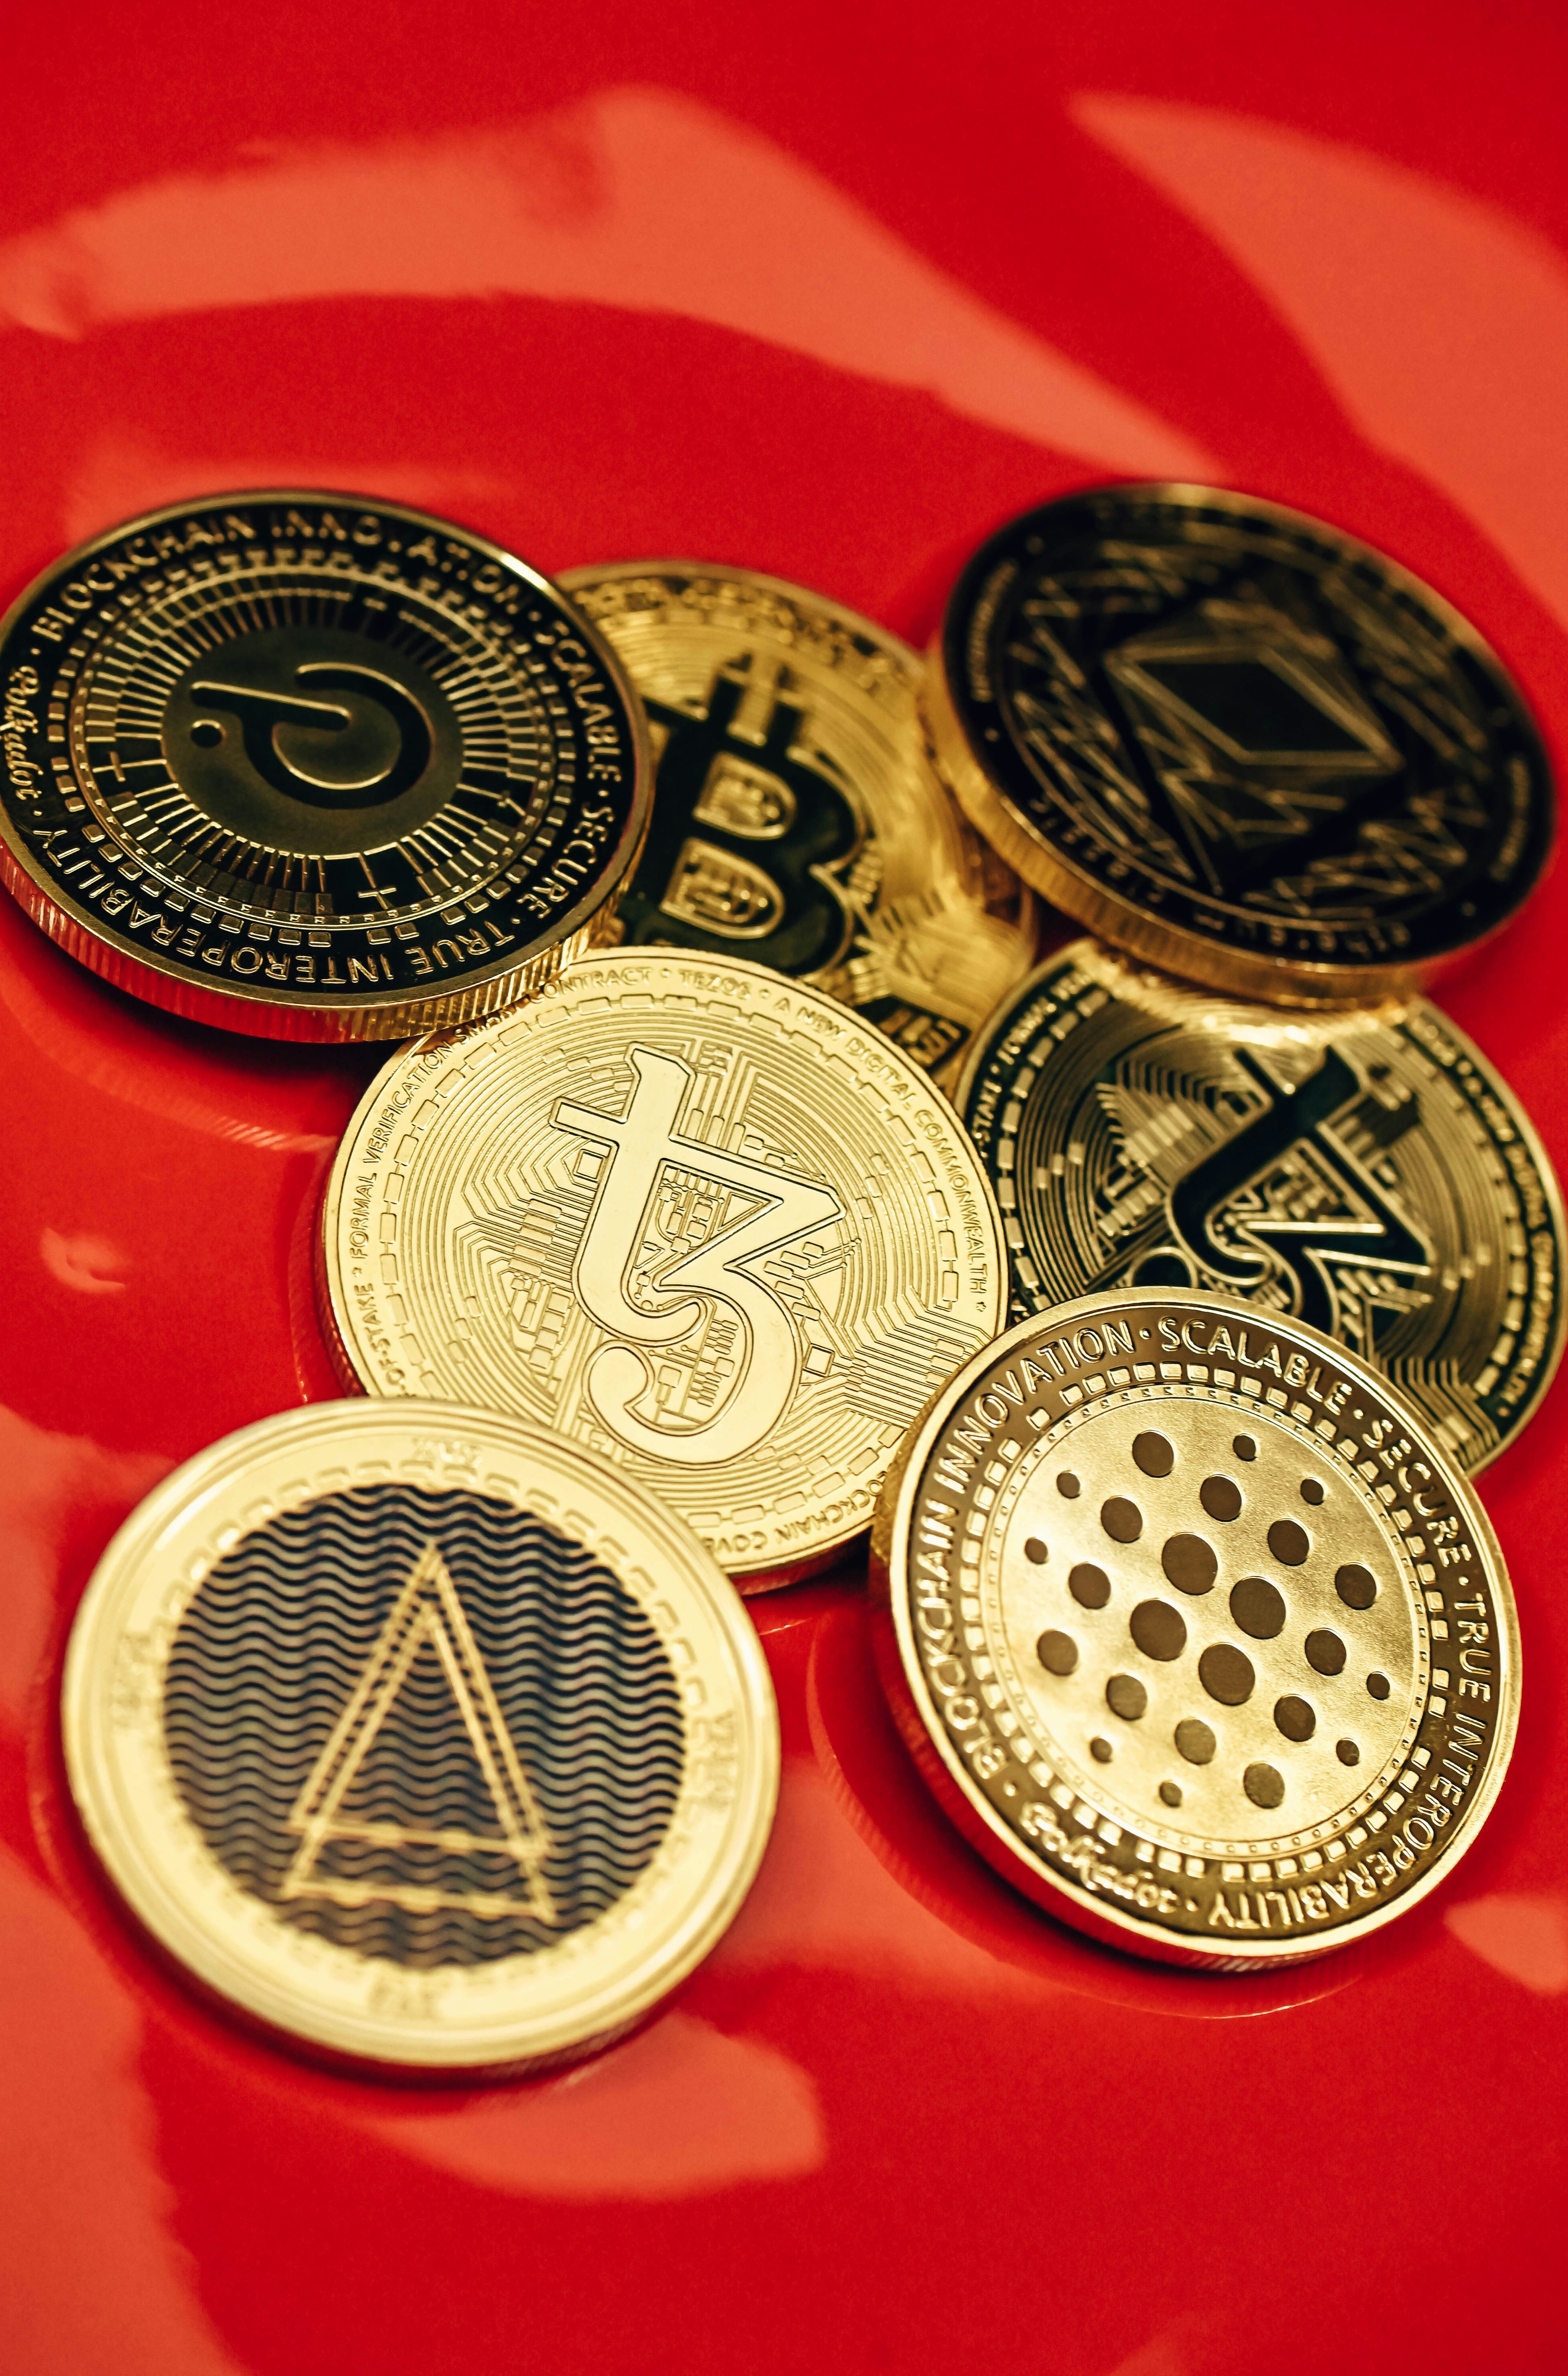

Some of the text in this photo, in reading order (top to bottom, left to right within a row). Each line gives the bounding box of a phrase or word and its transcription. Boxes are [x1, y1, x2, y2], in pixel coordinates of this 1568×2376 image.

[272, 509, 528, 615] INNOATION
[0, 666, 43, 800] Polkadot
[534, 621, 622, 782] SCALABLE
[32, 829, 515, 984] TRUE INTEROPERABILITY
[517, 802, 615, 919] SECURE
[678, 969, 751, 1000] TEZOS
[363, 1040, 455, 1163] VERIFICATION
[775, 997, 987, 1294] A NEW DIGITAL COMMONWEALTH
[350, 1172, 378, 1259] FORMAL
[1158, 1317, 1352, 1415] SCALABLE
[917, 1320, 1135, 1779] BLOCKCHAIN INNOVATION
[1363, 1419, 1471, 1567] SECURE
[1209, 1592, 1492, 1928] TRUE INTEROPERABILITY
